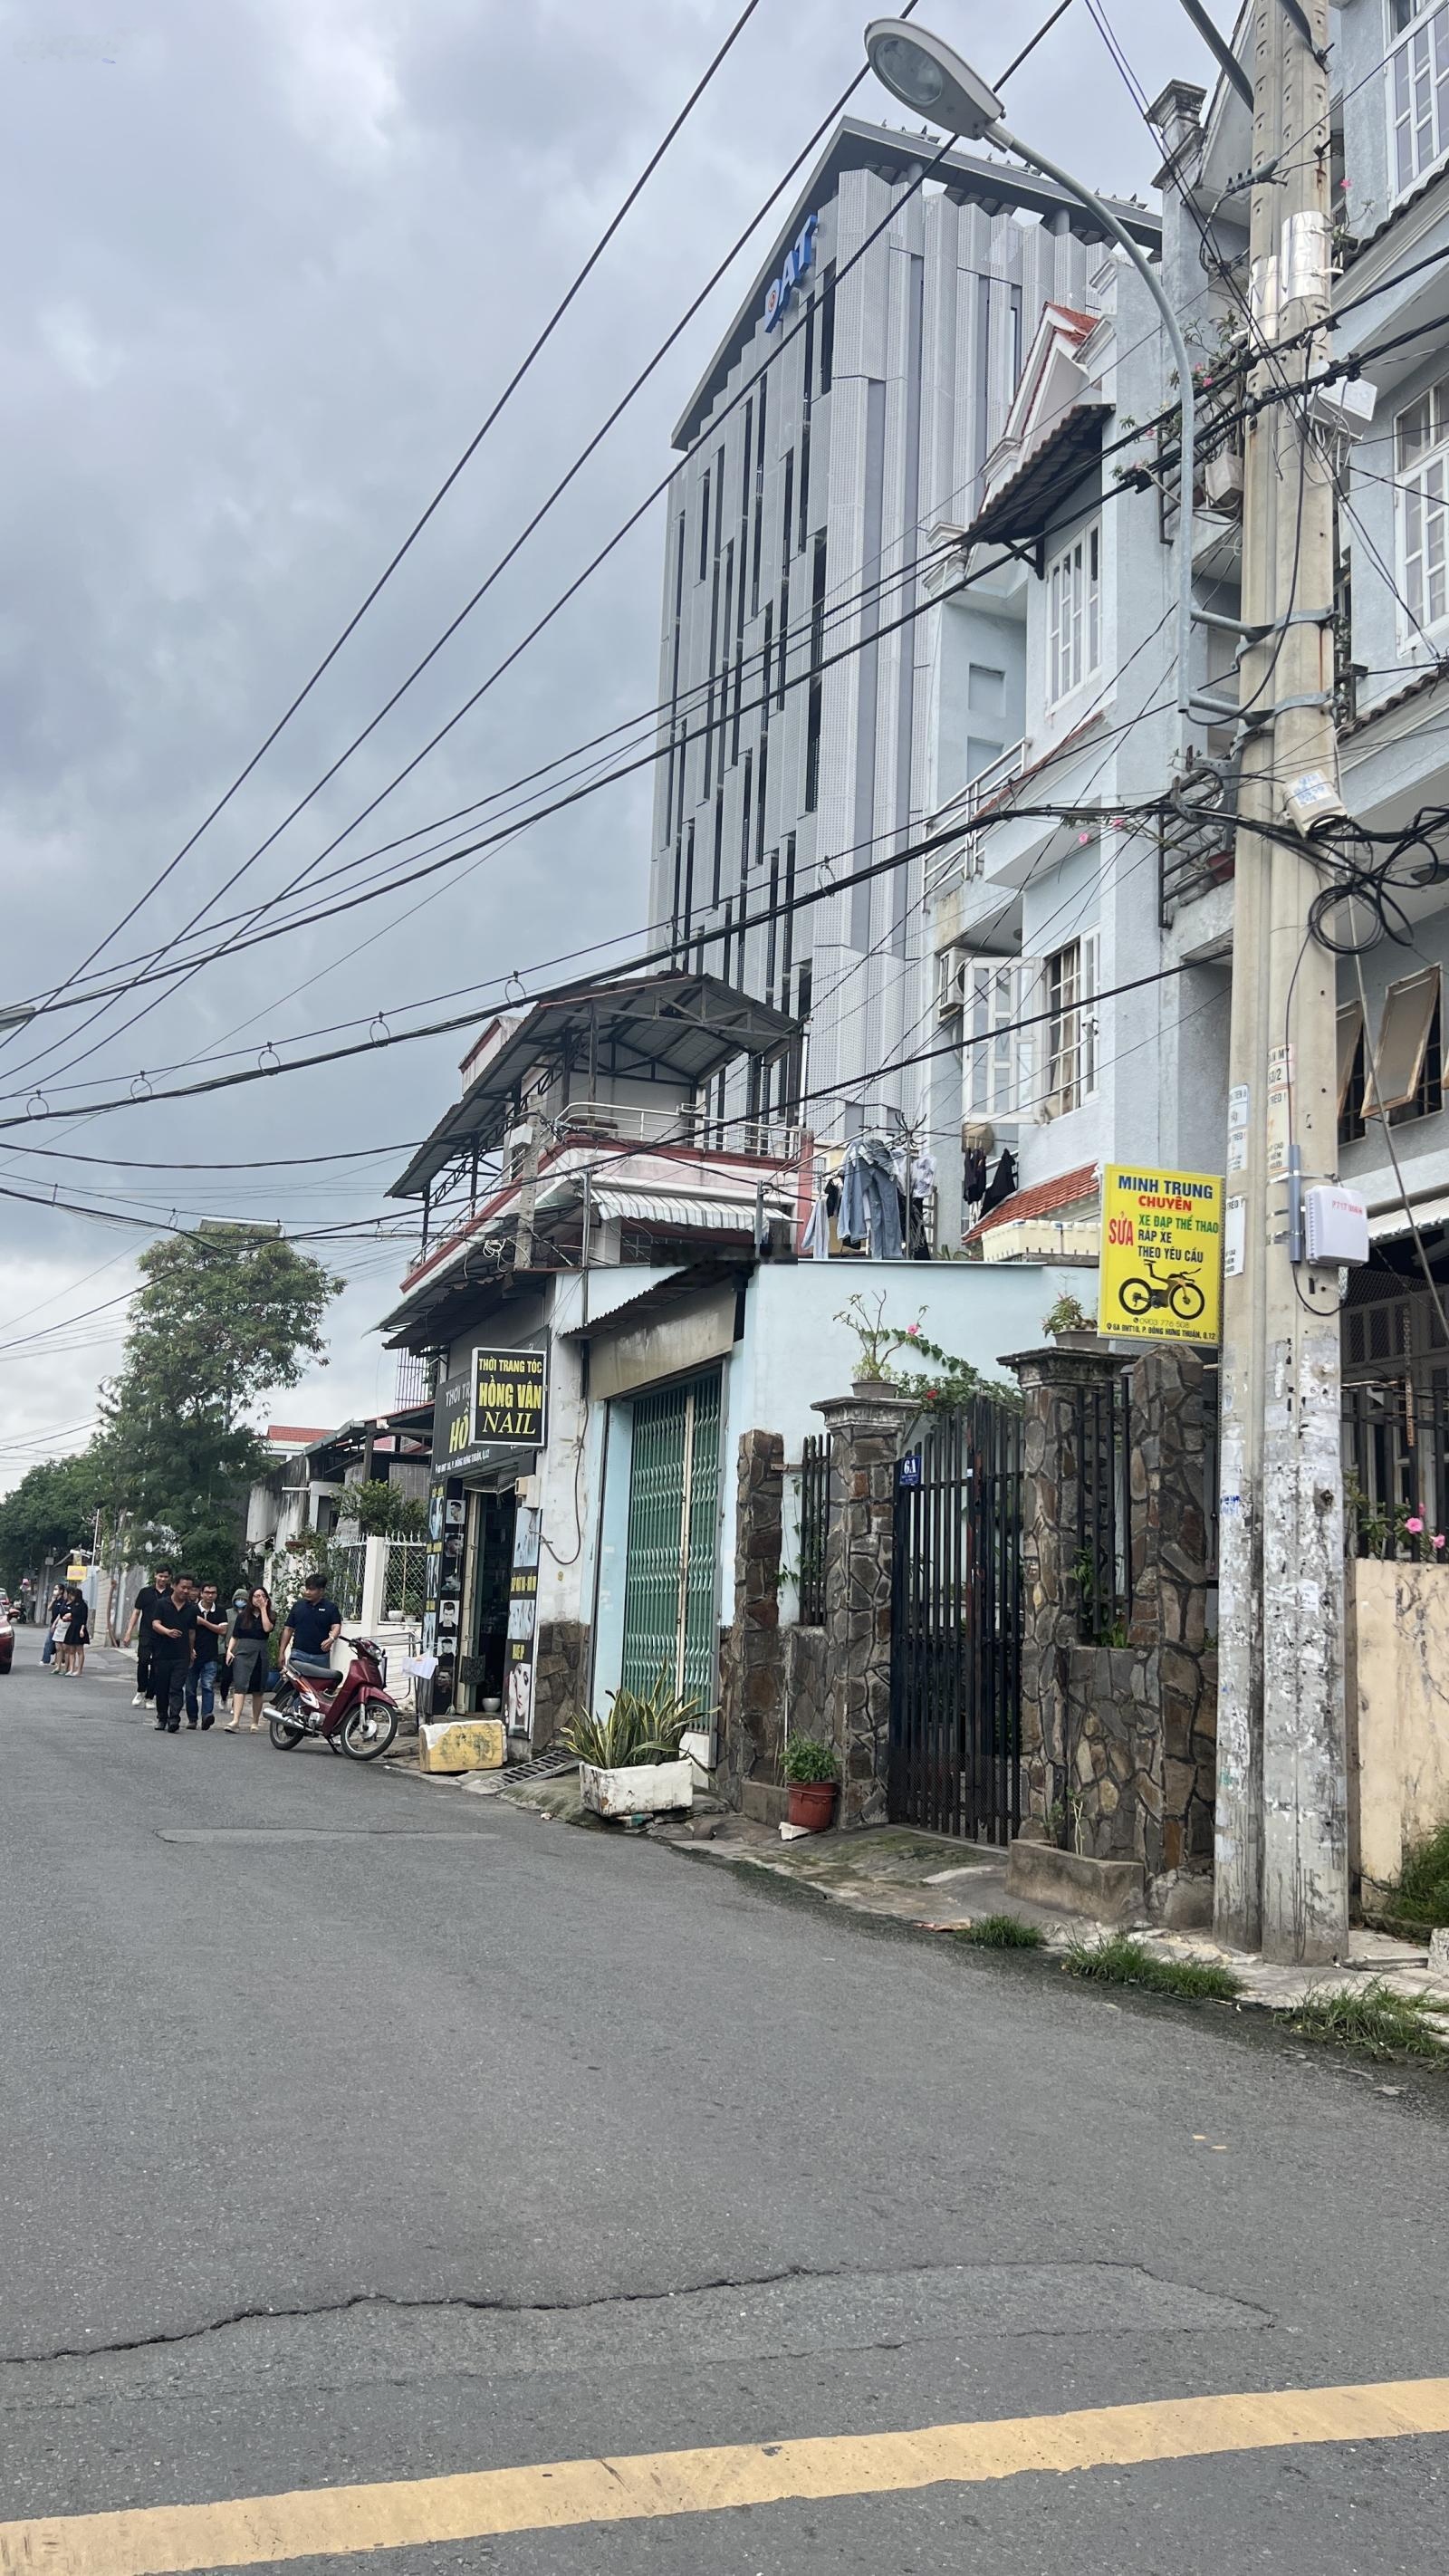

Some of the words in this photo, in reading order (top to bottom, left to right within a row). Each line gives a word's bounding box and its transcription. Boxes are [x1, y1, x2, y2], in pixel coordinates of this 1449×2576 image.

[1118, 1175, 1158, 1194] MINH
[1164, 1180, 1213, 1199] TRUNG
[1137, 1195, 1192, 1212] CHUYÊN
[1108, 1211, 1134, 1246] SỬA
[1138, 1214, 1150, 1226] XE
[1195, 1220, 1219, 1234] THAO
[1160, 1231, 1172, 1243] XE
[1137, 1245, 1161, 1259] THEO
[1164, 1246, 1182, 1261] YÊU
[479, 1356, 497, 1371] THỜI
[499, 1359, 525, 1373] TRANG
[527, 1359, 542, 1374] TÓC
[478, 1375, 513, 1408] HỒNG
[517, 1379, 542, 1409] VÂN
[449, 1401, 471, 1454] HỒ
[482, 1411, 536, 1435] NAIL
[904, 1458, 916, 1475] 6A
